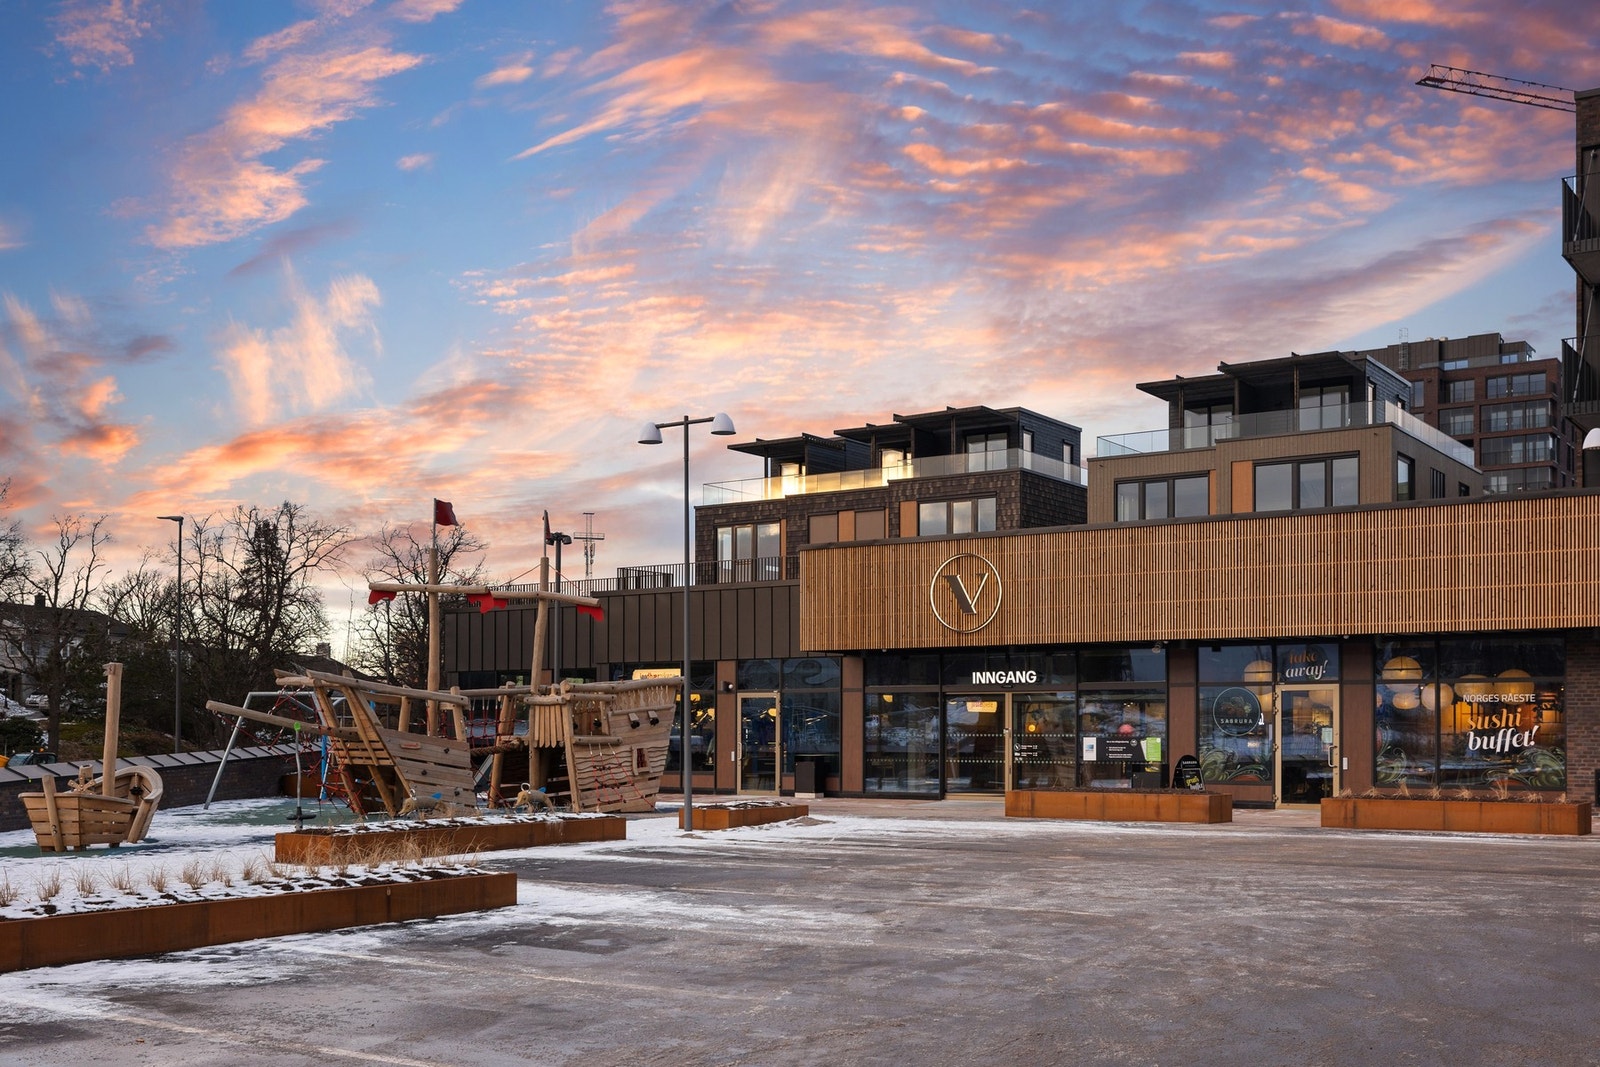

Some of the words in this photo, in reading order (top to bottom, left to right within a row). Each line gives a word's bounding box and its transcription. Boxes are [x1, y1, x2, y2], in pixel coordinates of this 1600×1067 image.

[972, 670, 1037, 684] INNGANG
[1285, 659, 1329, 680] away!
[1463, 694, 1500, 703] NORGES
[1501, 692, 1536, 702] RÅESTE
[1466, 707, 1522, 730] sushi
[1467, 725, 1539, 754] buffet!
